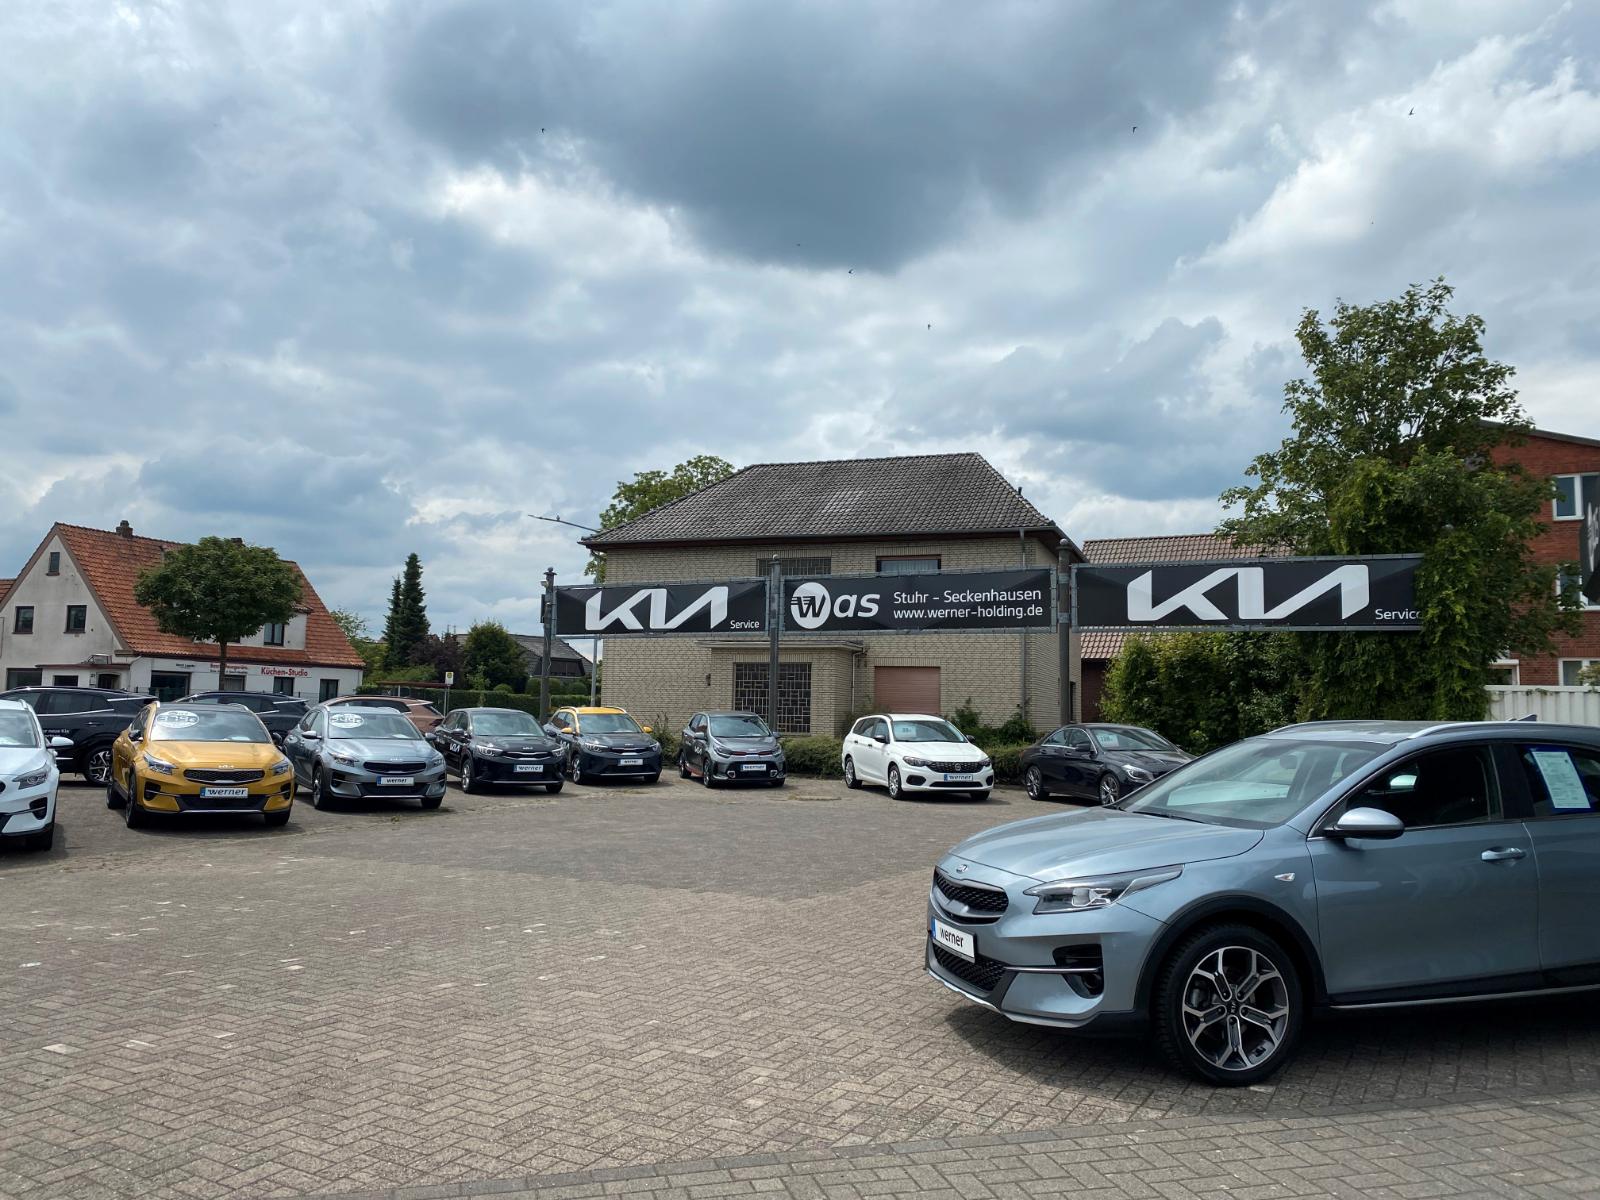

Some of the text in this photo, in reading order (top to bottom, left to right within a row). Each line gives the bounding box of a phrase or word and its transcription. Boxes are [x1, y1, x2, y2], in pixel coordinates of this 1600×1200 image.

[893, 591, 929, 604] Stuhr
[943, 589, 1042, 603] Seckenhausen
[1127, 564, 1370, 621] KIA
[585, 586, 729, 631] KIA
[893, 604, 1043, 619] www.werner-holding.de
[730, 619, 760, 630] Service
[261, 667, 309, 677] Küchen-Studio
[207, 788, 245, 796] werner
[940, 926, 964, 948] werner
